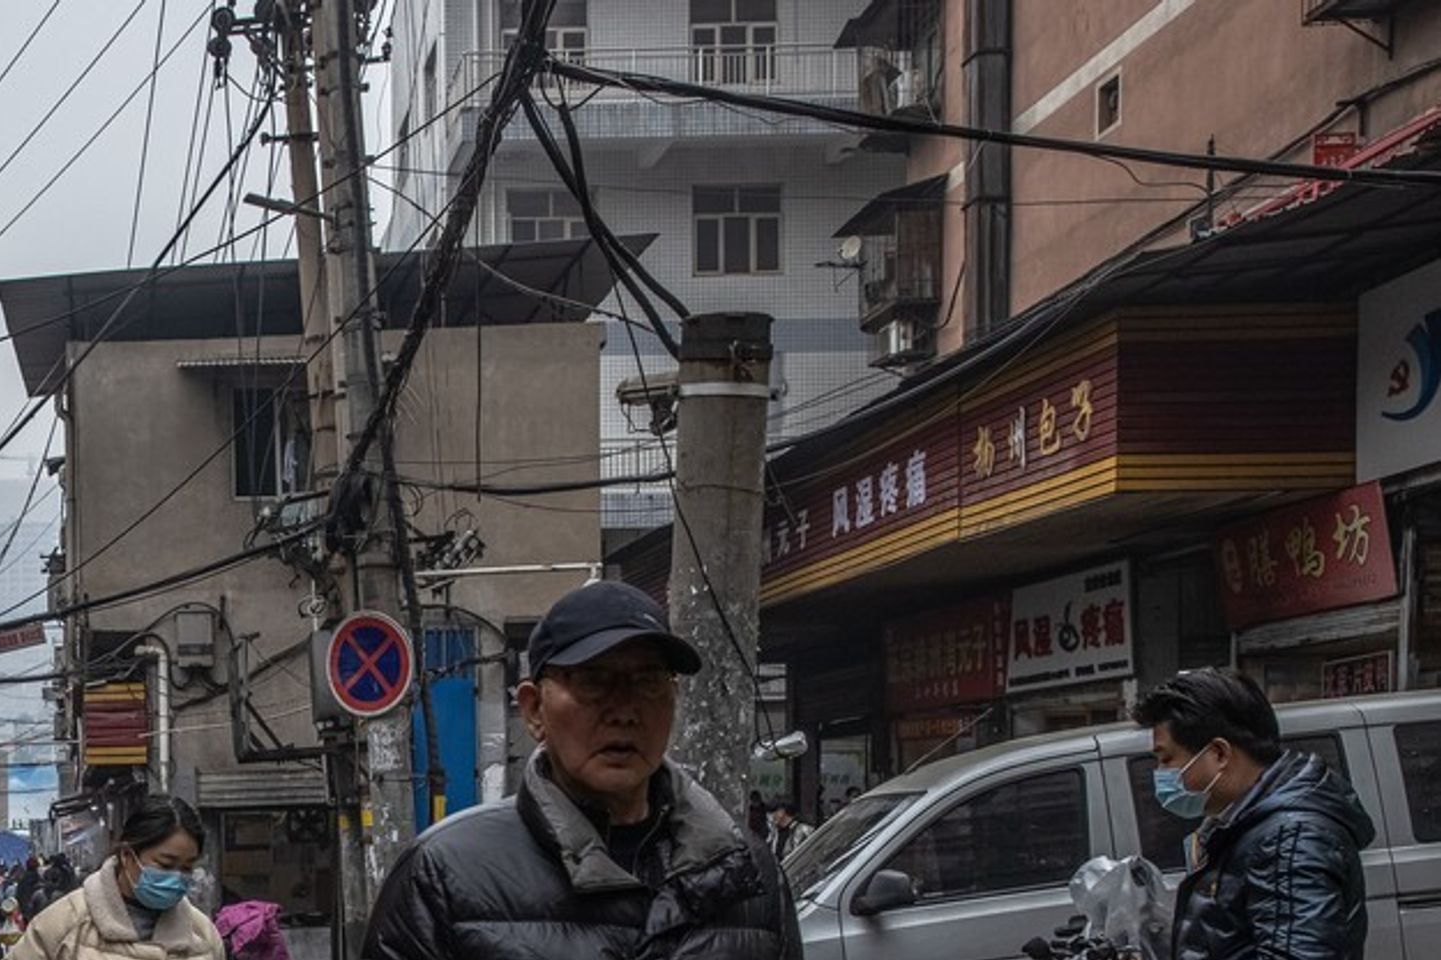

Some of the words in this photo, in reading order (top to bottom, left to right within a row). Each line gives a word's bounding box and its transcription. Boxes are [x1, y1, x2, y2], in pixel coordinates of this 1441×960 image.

[972, 379, 1096, 479] 扬州包子
[831, 449, 928, 539] 风湿疼痛
[1014, 615, 1053, 661] 风湿
[1080, 597, 1125, 650] 疼痛
